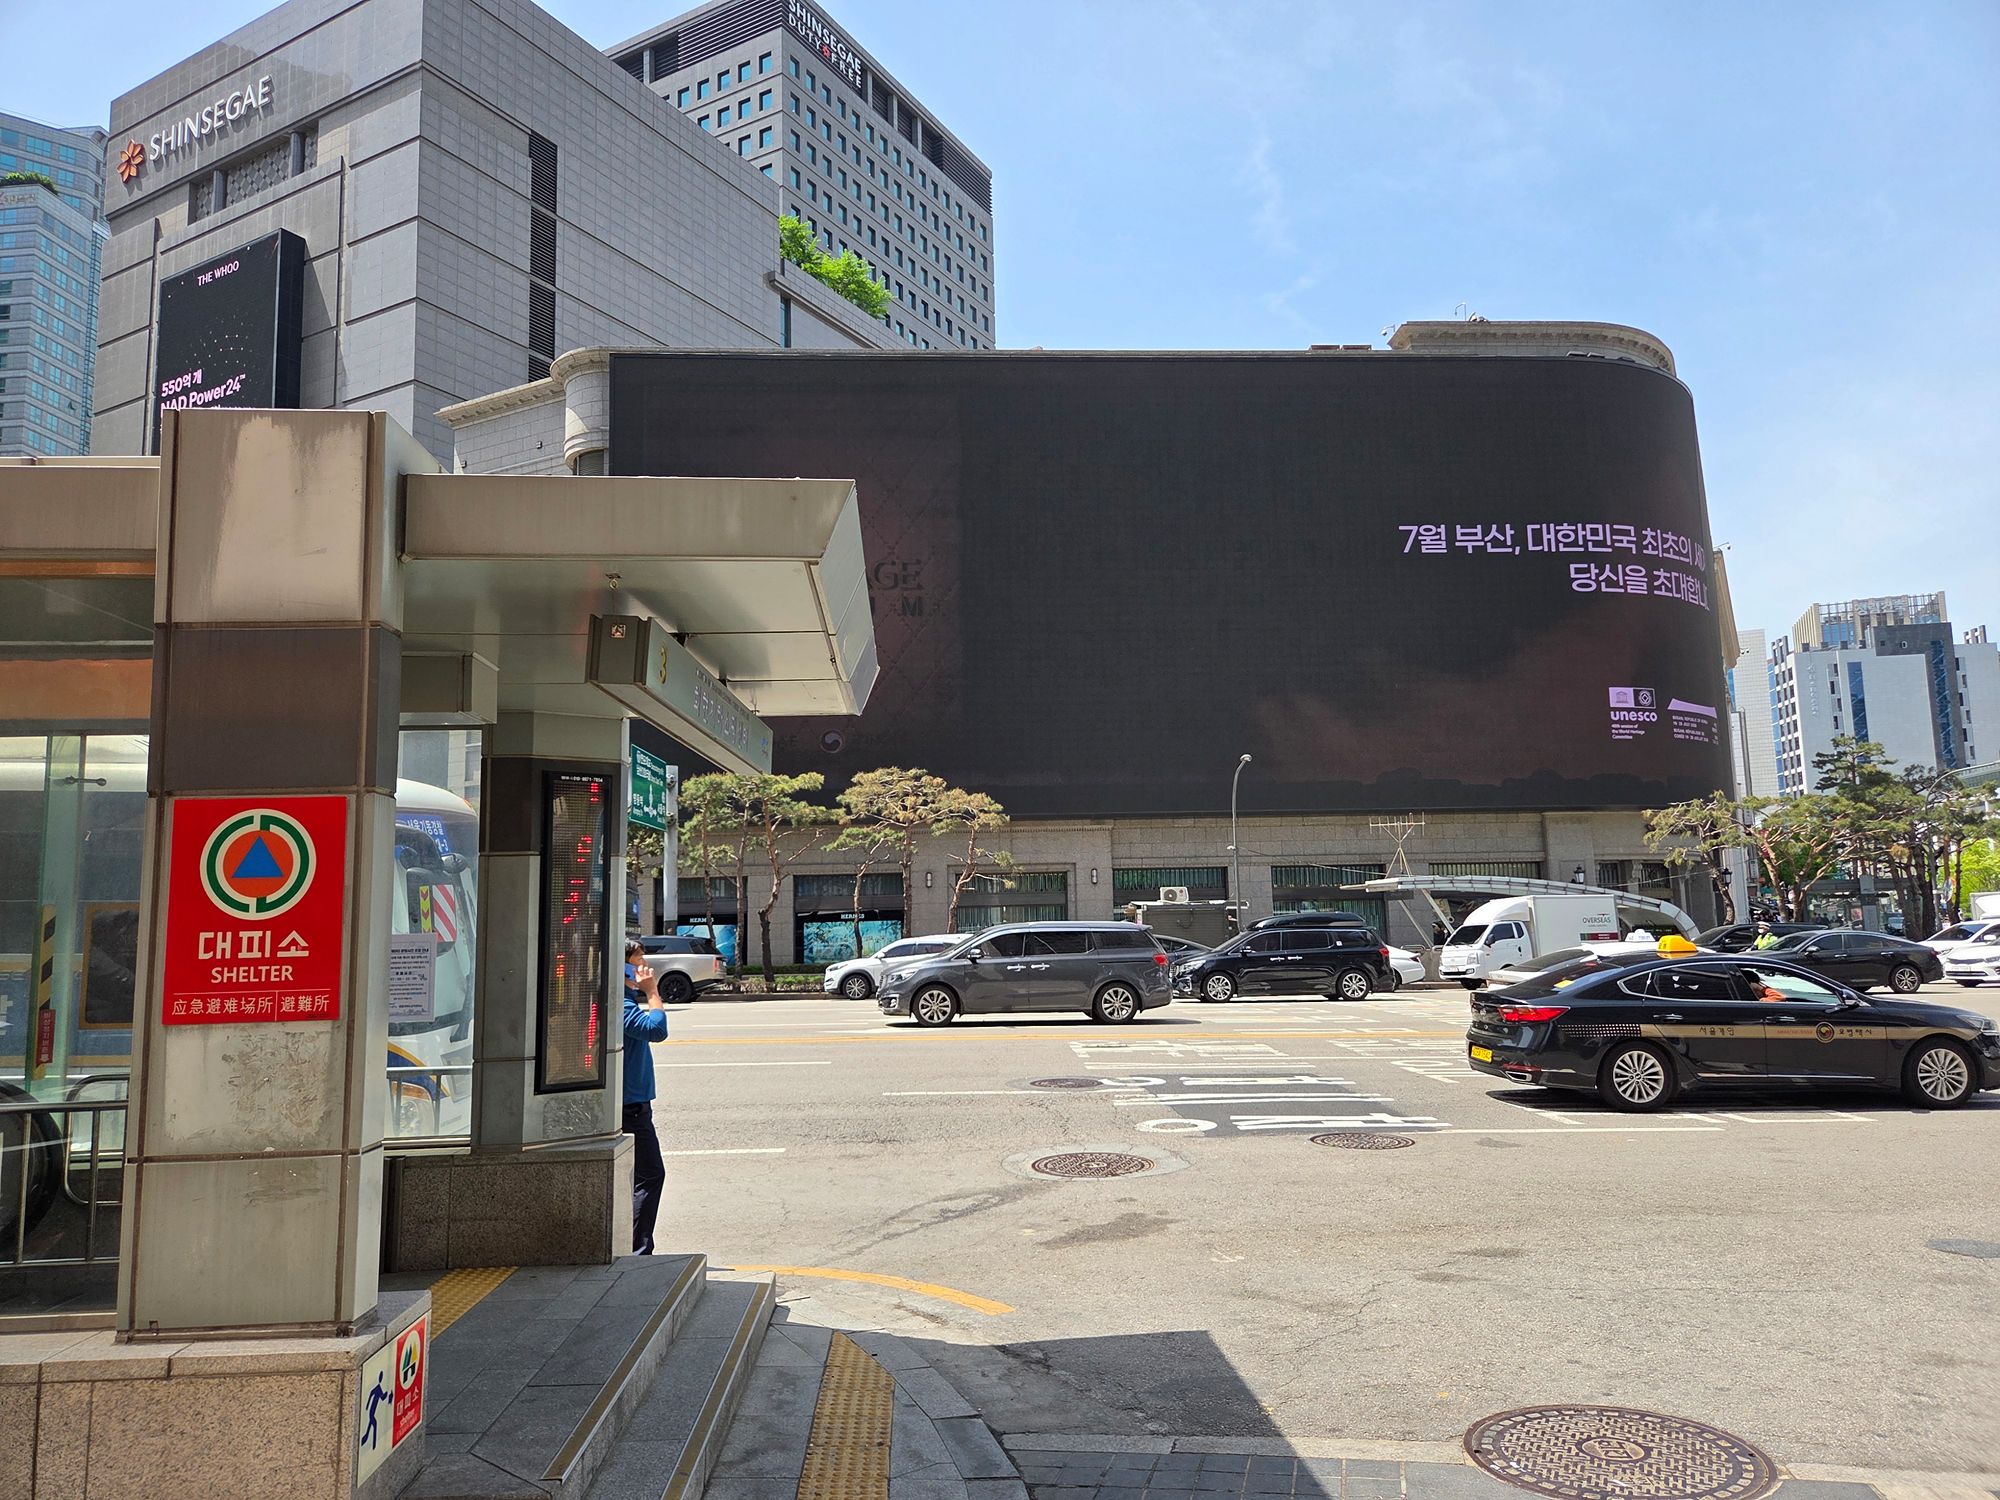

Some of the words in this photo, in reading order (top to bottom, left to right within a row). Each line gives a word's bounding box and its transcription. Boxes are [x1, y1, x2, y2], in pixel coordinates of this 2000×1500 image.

[788, 0, 861, 75] SHINSEGAE
[788, 13, 821, 50] DUTY
[831, 52, 862, 88] FREE
[149, 74, 272, 161] SHINSEGAE
[197, 271, 213, 286] THE
[214, 260, 240, 281] WHOO
[161, 372, 192, 398] 550억
[192, 368, 203, 384] 개
[1398, 524, 1448, 554] 7월
[1455, 523, 1521, 556] 부산,
[1526, 522, 1637, 554] 대한민국
[1642, 527, 1693, 566] 최초의
[1569, 563, 1648, 595] 당신을
[659, 644, 667, 685] 3
[1610, 711, 1658, 722] unesco
[1582, 916, 1612, 924] OVERSEAS
[198, 930, 310, 960] 대피소
[210, 965, 294, 984] SHELTER
[172, 996, 274, 1016] 应急避难场所
[280, 994, 330, 1013] 避難所
